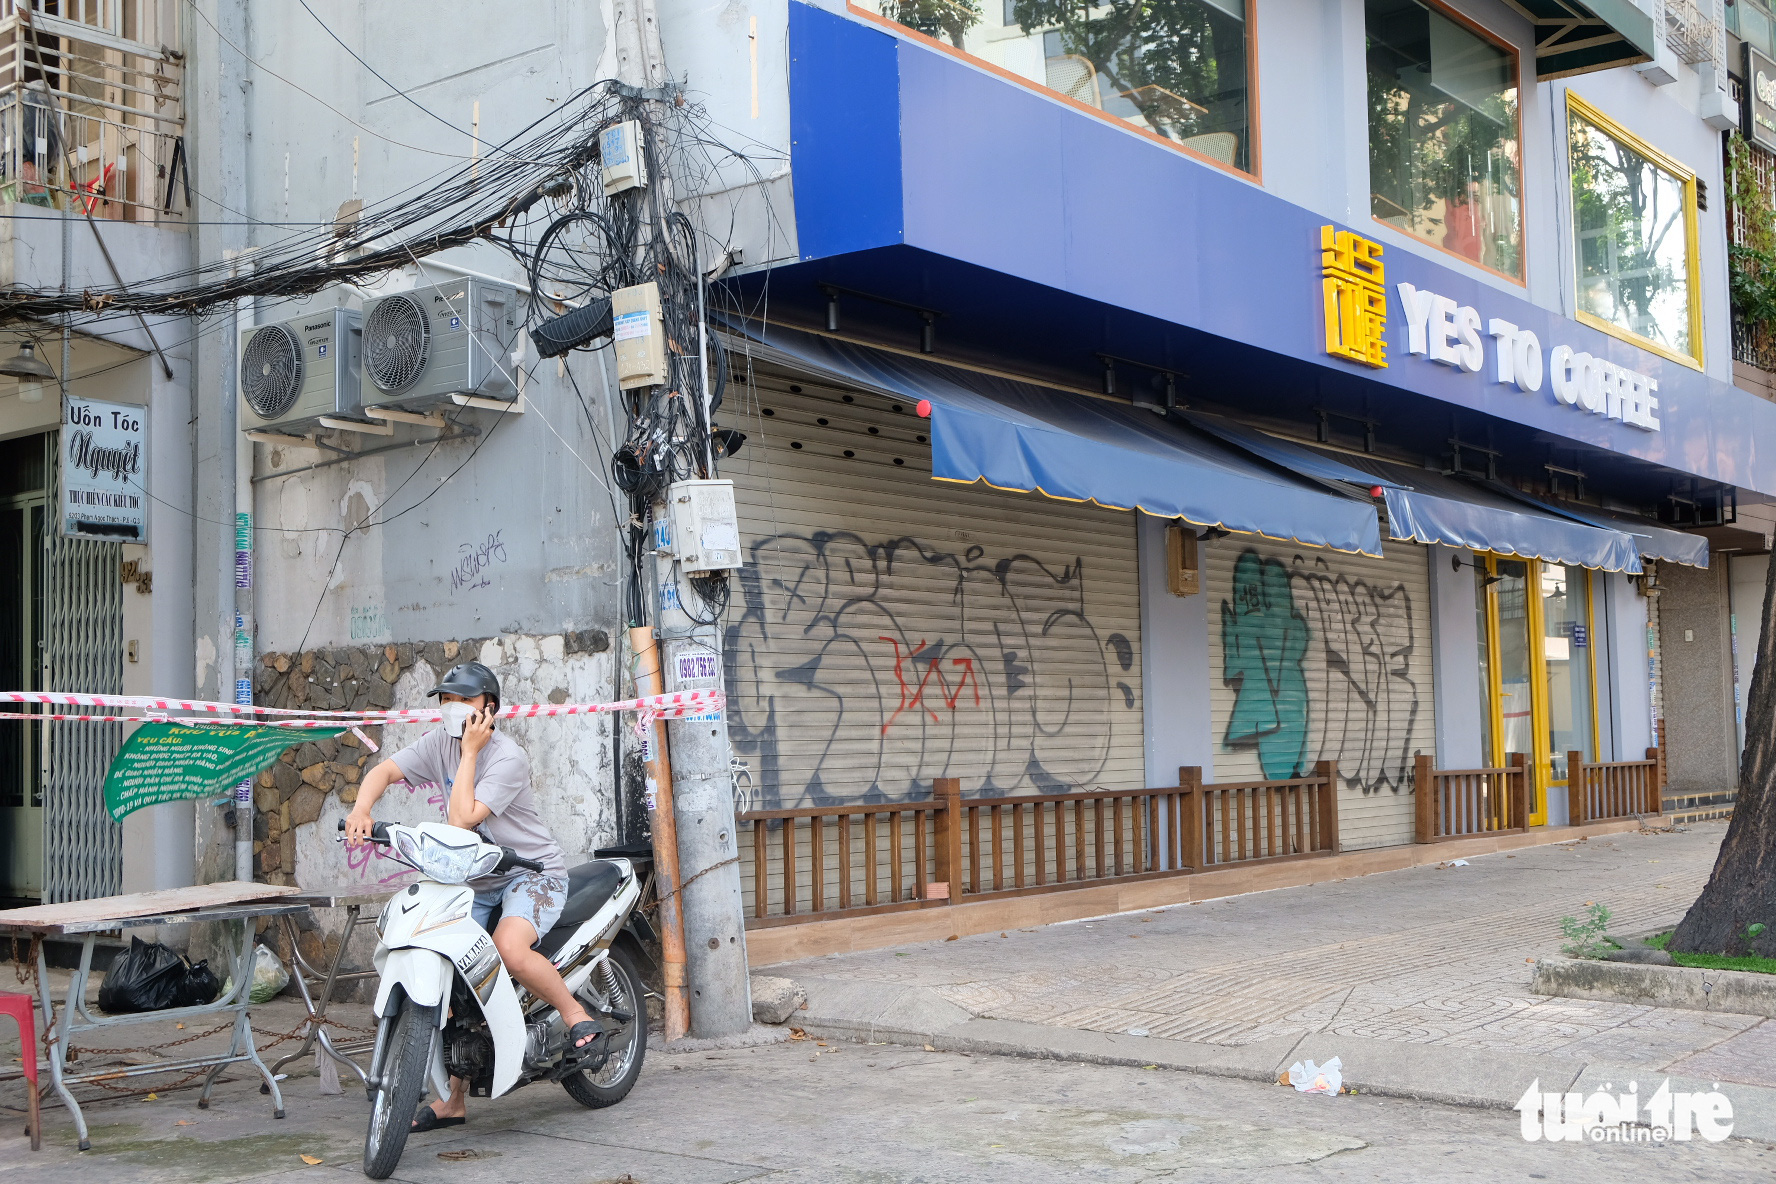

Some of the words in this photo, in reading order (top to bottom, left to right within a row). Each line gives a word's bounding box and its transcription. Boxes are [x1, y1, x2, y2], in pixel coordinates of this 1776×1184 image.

[304, 321, 331, 332] Panasonic
[1398, 282, 1484, 373] YES
[1489, 318, 1543, 392] TO
[1551, 344, 1661, 432] COFFEE
[71, 405, 101, 427] Uốn
[111, 411, 139, 432] Tóc
[69, 429, 140, 484] Nguyệt
[129, 493, 140, 509] TÓC
[458, 934, 489, 970] YAMAHA
